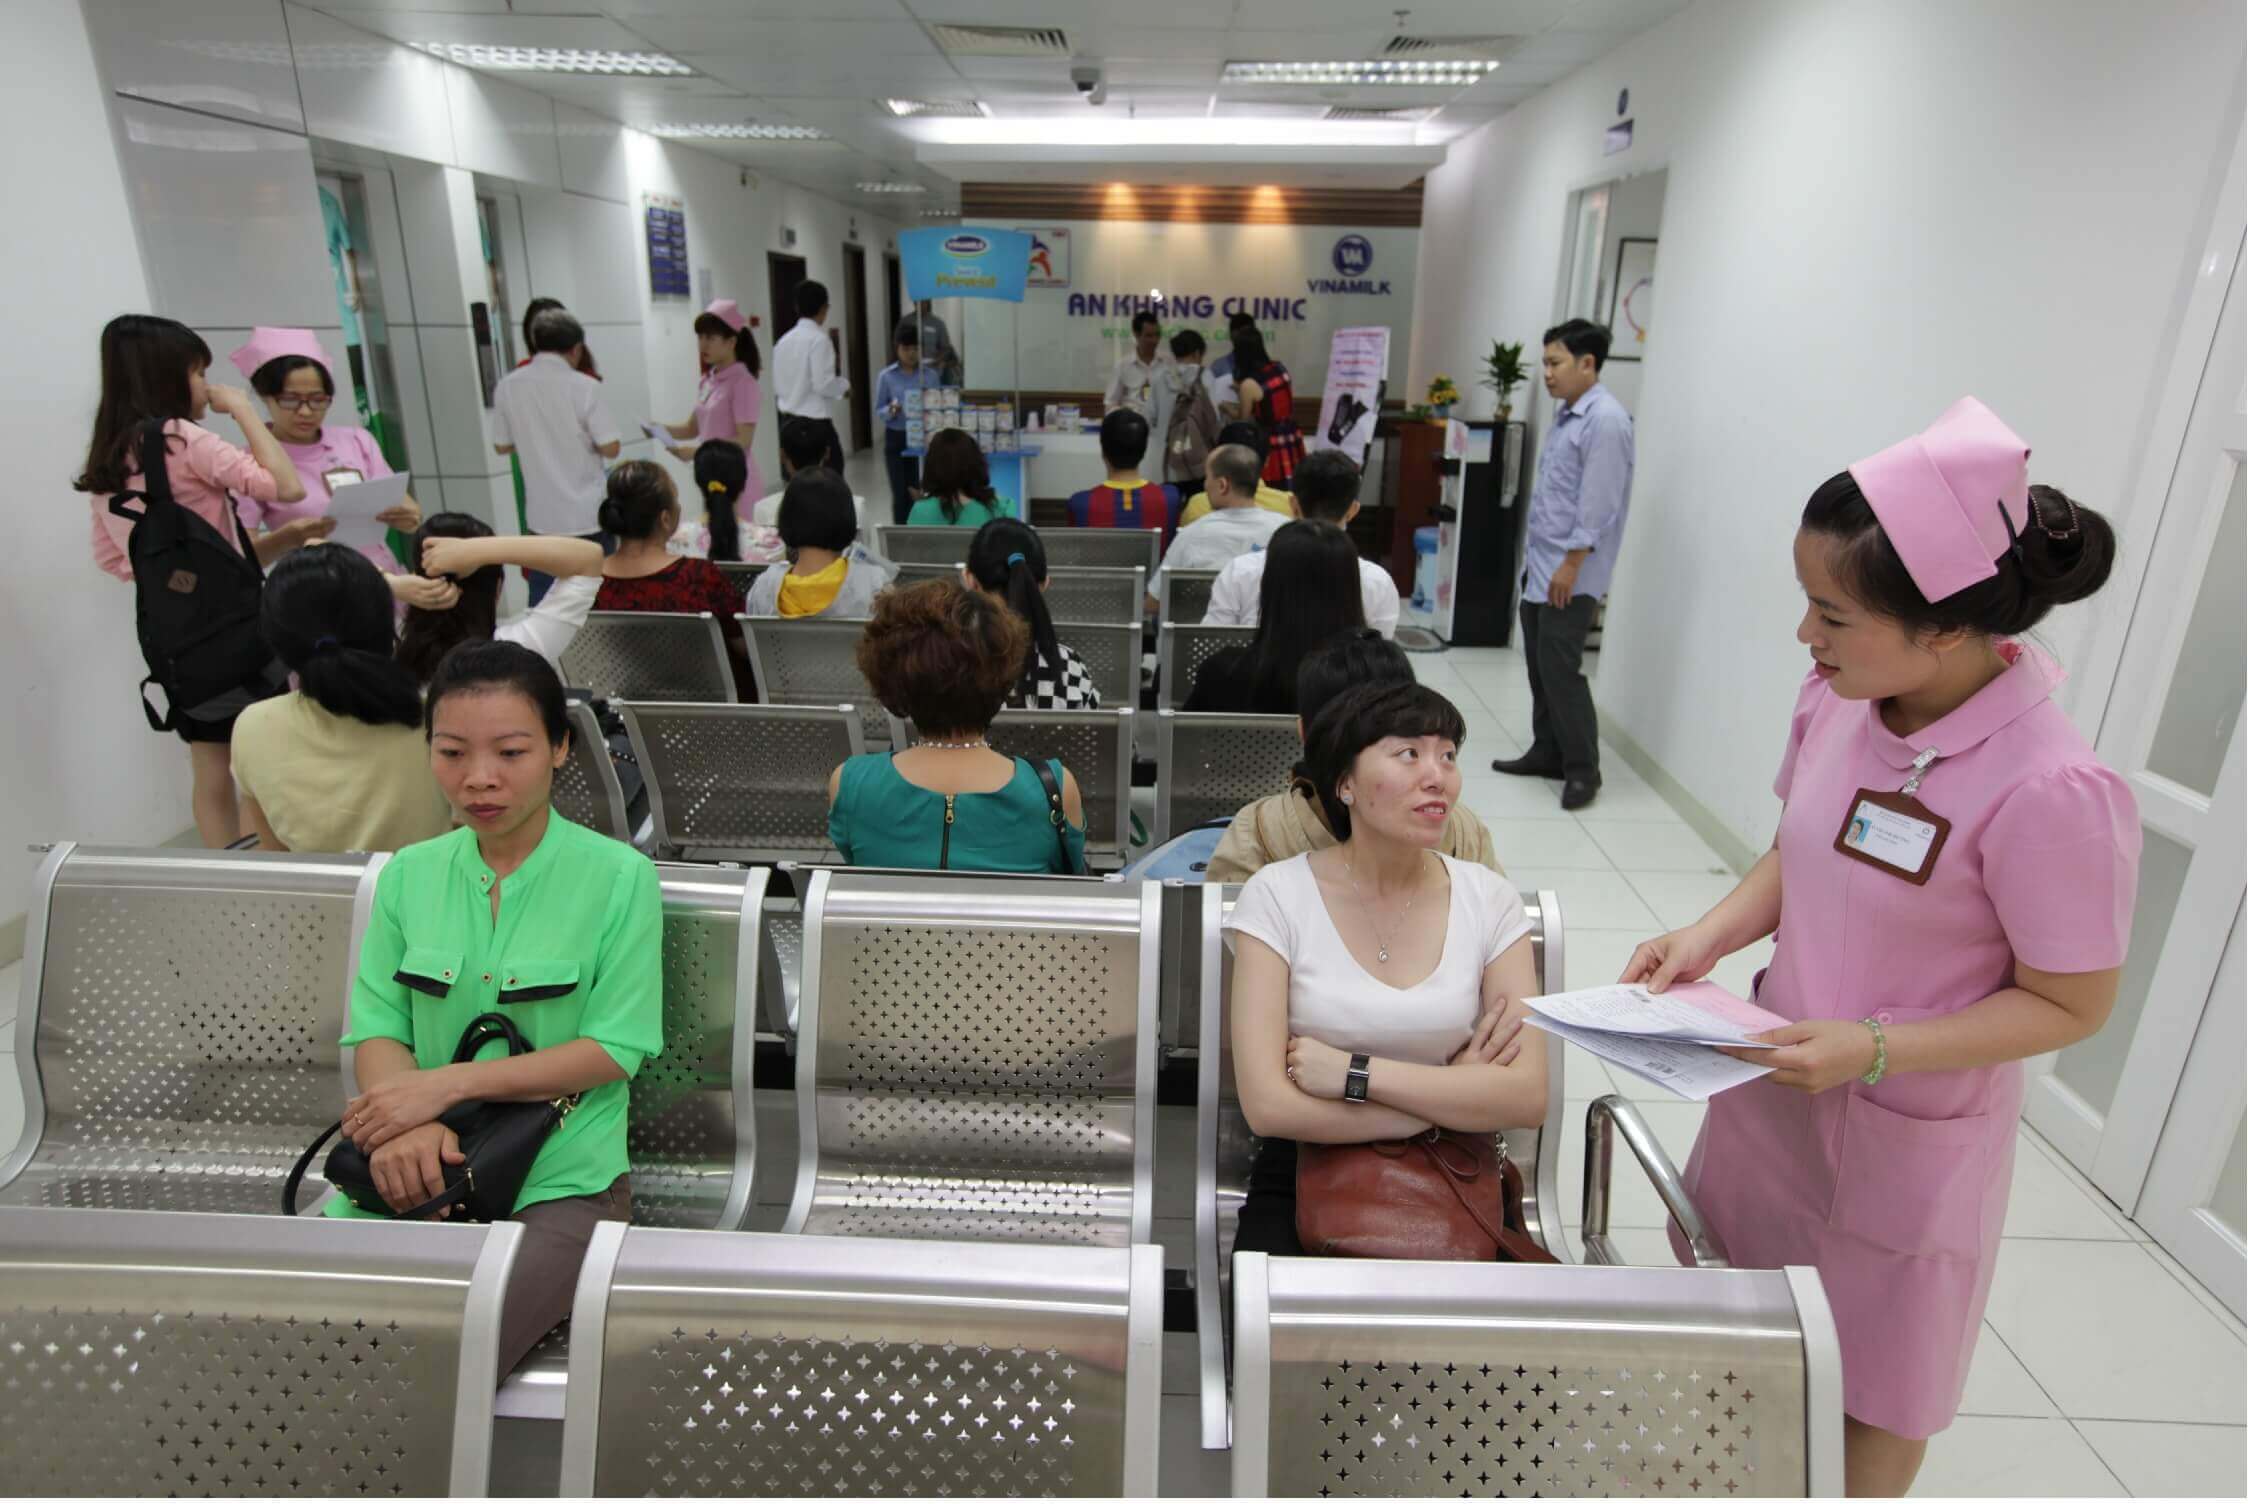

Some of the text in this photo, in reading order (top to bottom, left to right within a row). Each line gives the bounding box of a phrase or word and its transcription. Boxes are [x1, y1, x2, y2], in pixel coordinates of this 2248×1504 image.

[1306, 279, 1392, 296] VINAMILK
[1068, 293, 1106, 317] AN
[1112, 294, 1215, 319] KHANG
